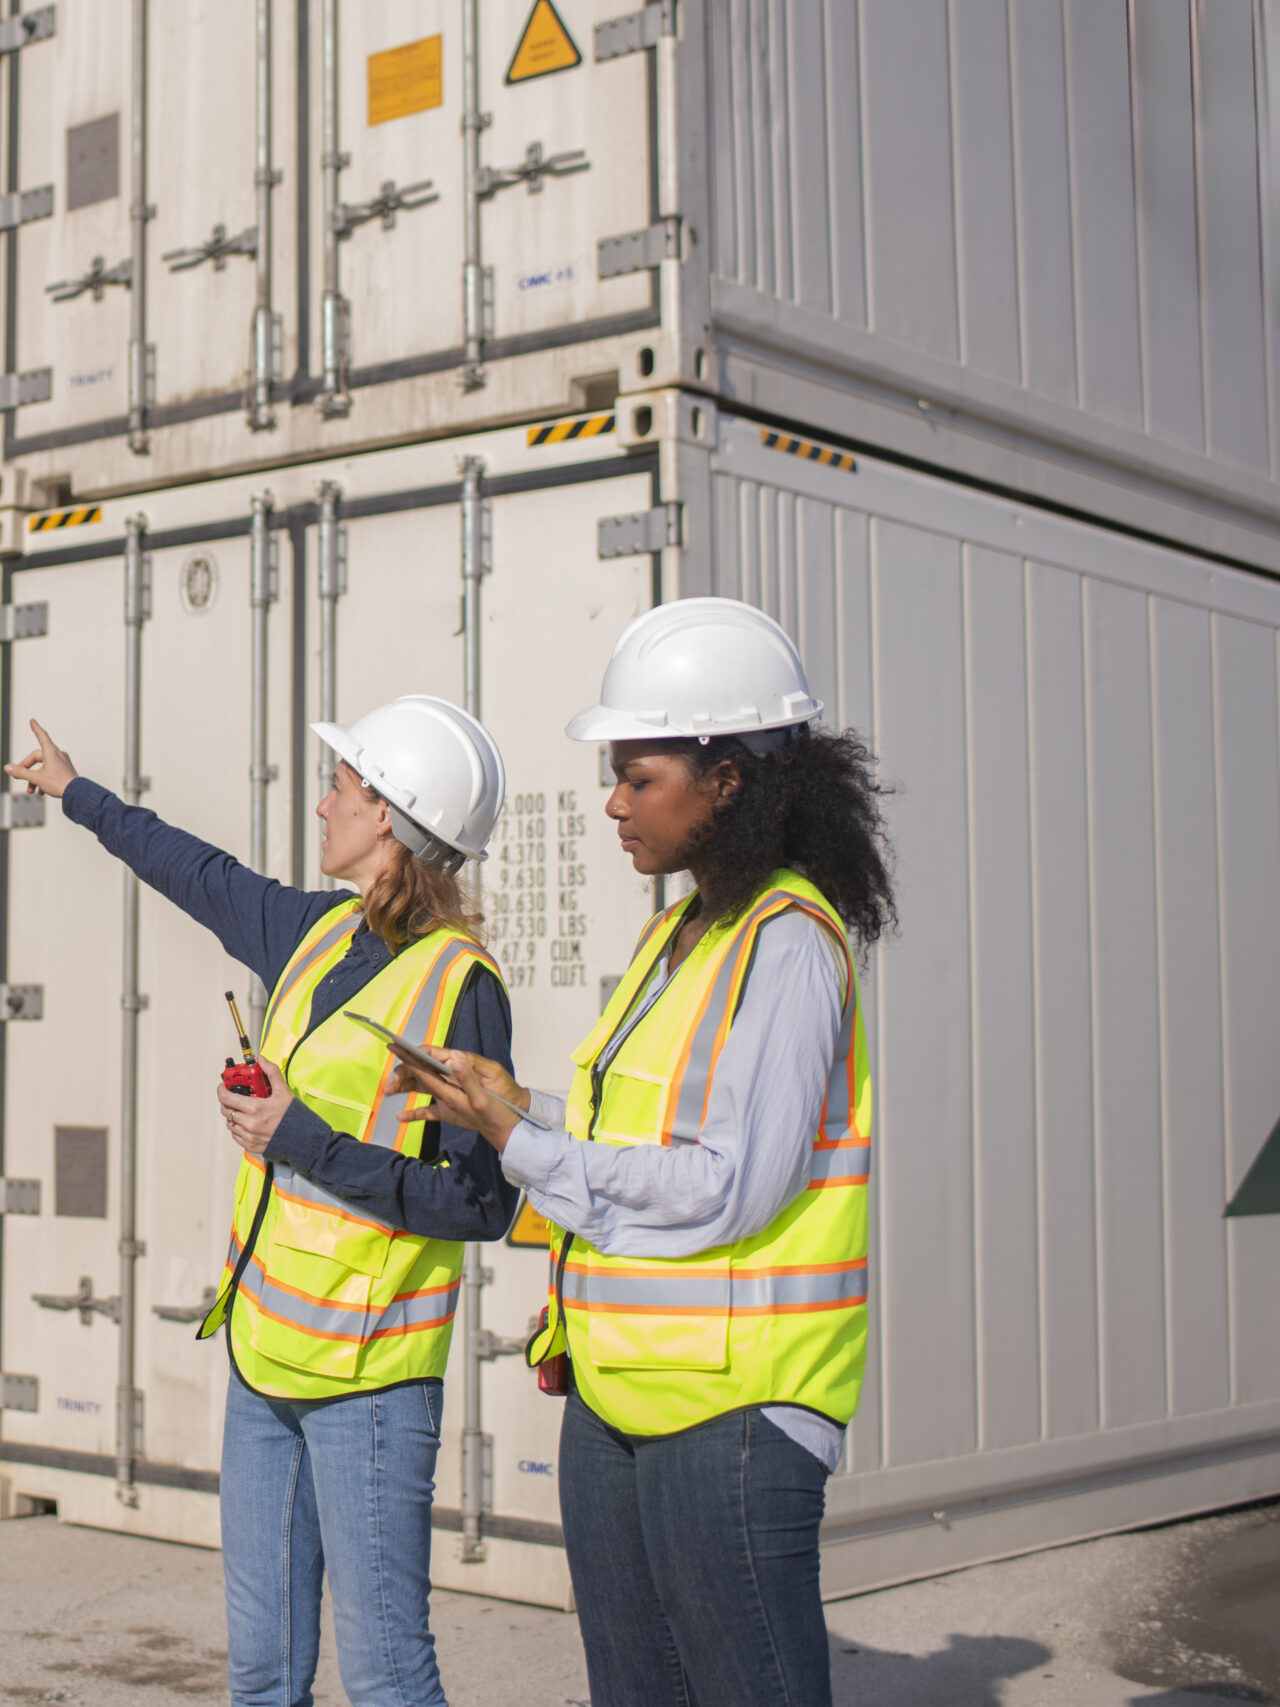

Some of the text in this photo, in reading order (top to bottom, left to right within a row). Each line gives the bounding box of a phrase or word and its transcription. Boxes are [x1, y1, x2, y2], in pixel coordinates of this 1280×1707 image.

[558, 790, 576, 812] KG
[558, 814, 585, 837] LBS
[500, 839, 576, 865] 4.370 KG
[501, 863, 586, 889] 9.630 LBS
[559, 889, 577, 912] KG
[559, 913, 587, 937] LBS
[501, 941, 535, 963] 67.9
[518, 1460, 554, 1477] CIMC
